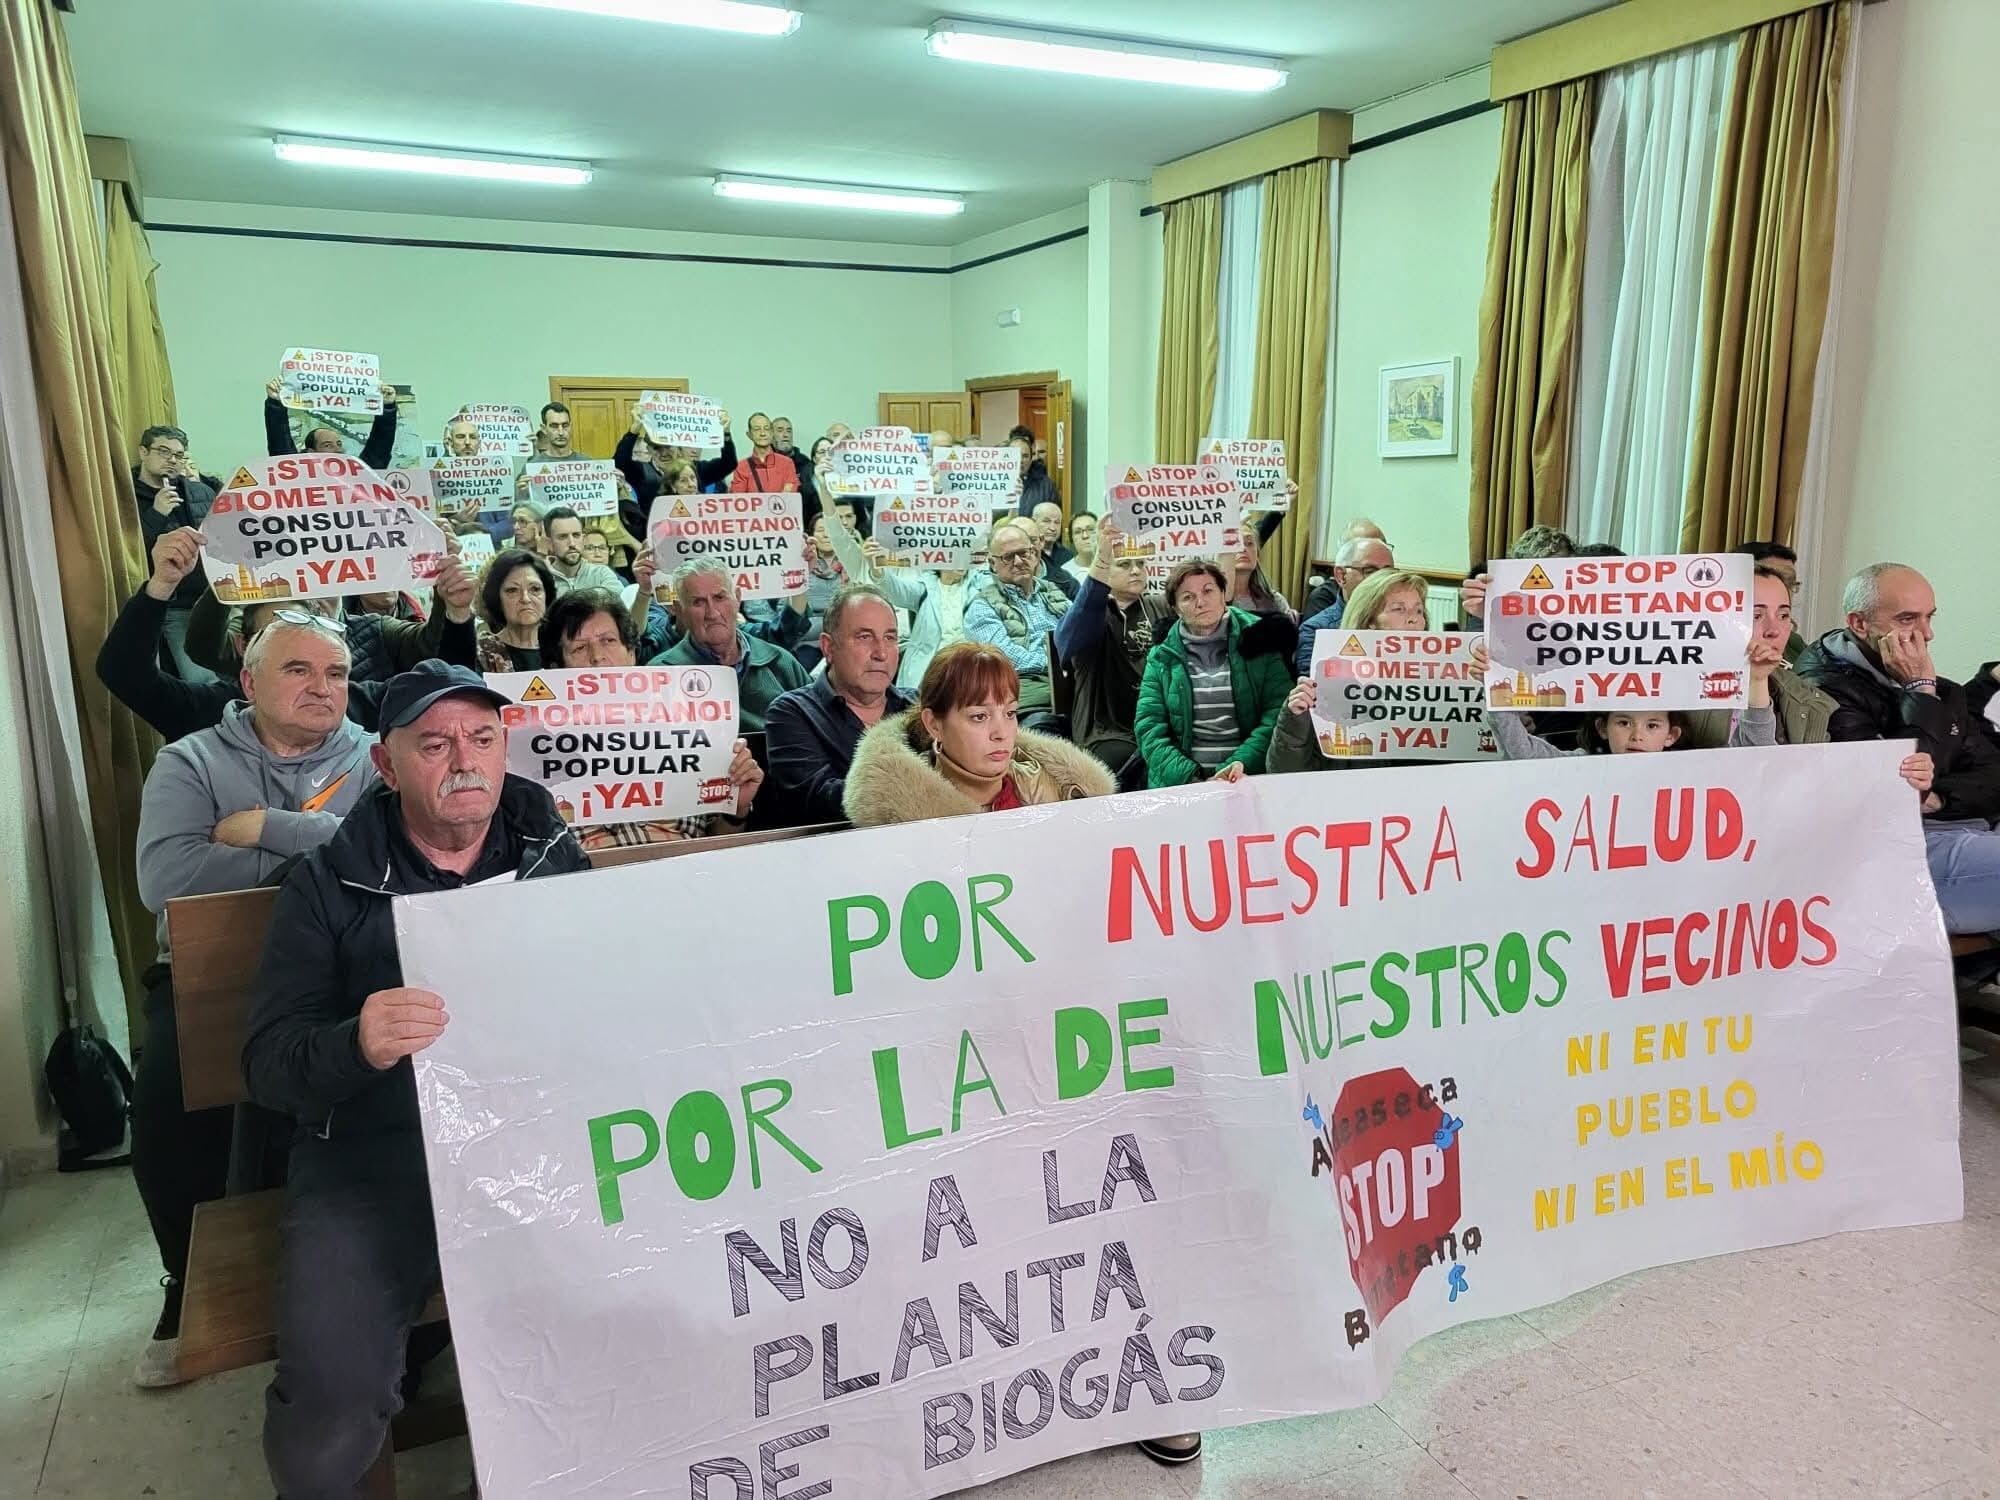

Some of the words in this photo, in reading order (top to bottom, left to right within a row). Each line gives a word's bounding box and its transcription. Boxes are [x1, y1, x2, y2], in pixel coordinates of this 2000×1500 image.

[284, 361, 378, 376] BIOMETANO!
[297, 373, 370, 386] CONSULTA
[302, 383, 365, 396] POPULAR
[318, 395, 351, 407] ¡YA!
[478, 424, 520, 432] NSULTA
[654, 413, 712, 425] CONSULTA
[658, 422, 708, 432] POPULAR
[843, 454, 918, 464] CONSULTA
[848, 465, 914, 475] POPULAR
[1147, 468, 1196, 482] ¡STOP
[438, 479, 503, 487] CONSULTA
[442, 488, 500, 496] POPULAR
[544, 483, 605, 493] CONSULTA
[549, 492, 602, 501] POPULAR
[911, 498, 959, 510] ¡STOP
[1132, 498, 1226, 514] CONSULTA
[698, 498, 763, 517] ¡STOP
[239, 507, 414, 537] CONSULTA
[1139, 512, 1222, 530] POPULAR
[893, 526, 976, 536] CONSULTA
[1160, 530, 1206, 551] ¡YA!
[253, 531, 407, 559] POPULAR
[676, 536, 788, 554] CONSULTA
[898, 539, 971, 547] POPULAR
[915, 551, 953, 565] ¡YA!
[297, 557, 377, 592] ¡YA!
[1565, 561, 1677, 590] ¡STOP
[1502, 591, 1744, 615] BIOMETANO!
[1526, 620, 1716, 641] CONSULTA
[1376, 636, 1462, 657] ¡STOP
[1536, 646, 1704, 665] POPULAR
[567, 672, 672, 700] ¡STOP
[1574, 672, 1662, 703] ¡YA!
[1704, 679, 1738, 692] STOP
[501, 700, 732, 729] BIOMETANO!
[1352, 705, 1482, 723] POPULAR
[531, 729, 711, 754] CONSULTA
[1380, 727, 1449, 752] ¡YA!
[543, 754, 700, 779] POPULAR
[583, 782, 664, 818] ¡YA!
[828, 873, 1036, 996] POR
[1107, 806, 1462, 942] NUESTRA
[1516, 787, 1756, 879] SALUD,
[1567, 1034, 1609, 1076] NI
[1634, 1022, 1688, 1065] EN
[1704, 1014, 1753, 1055] TU
[588, 1080, 823, 1227] POR
[872, 1029, 1007, 1149] LA
[1054, 998, 1175, 1100] DE
[1254, 930, 1572, 1076] NUESTROS
[1600, 896, 1837, 999] VECINOS
[1576, 1079, 1756, 1146] PUEBLO
[1534, 1183, 1576, 1232] NI
[1594, 1166, 1645, 1216] EN
[1666, 1156, 1712, 1200] EL
[1729, 1135, 1825, 1191] MÍO
[1339, 1143, 1445, 1261] STOP
[725, 1207, 870, 1318] NO
[922, 1175, 978, 1262] A
[1042, 1134, 1157, 1225] LA
[754, 1240, 1146, 1419] PLANTA
[689, 1424, 832, 1500] DE
[923, 1311, 1226, 1470] BIOGÁS
